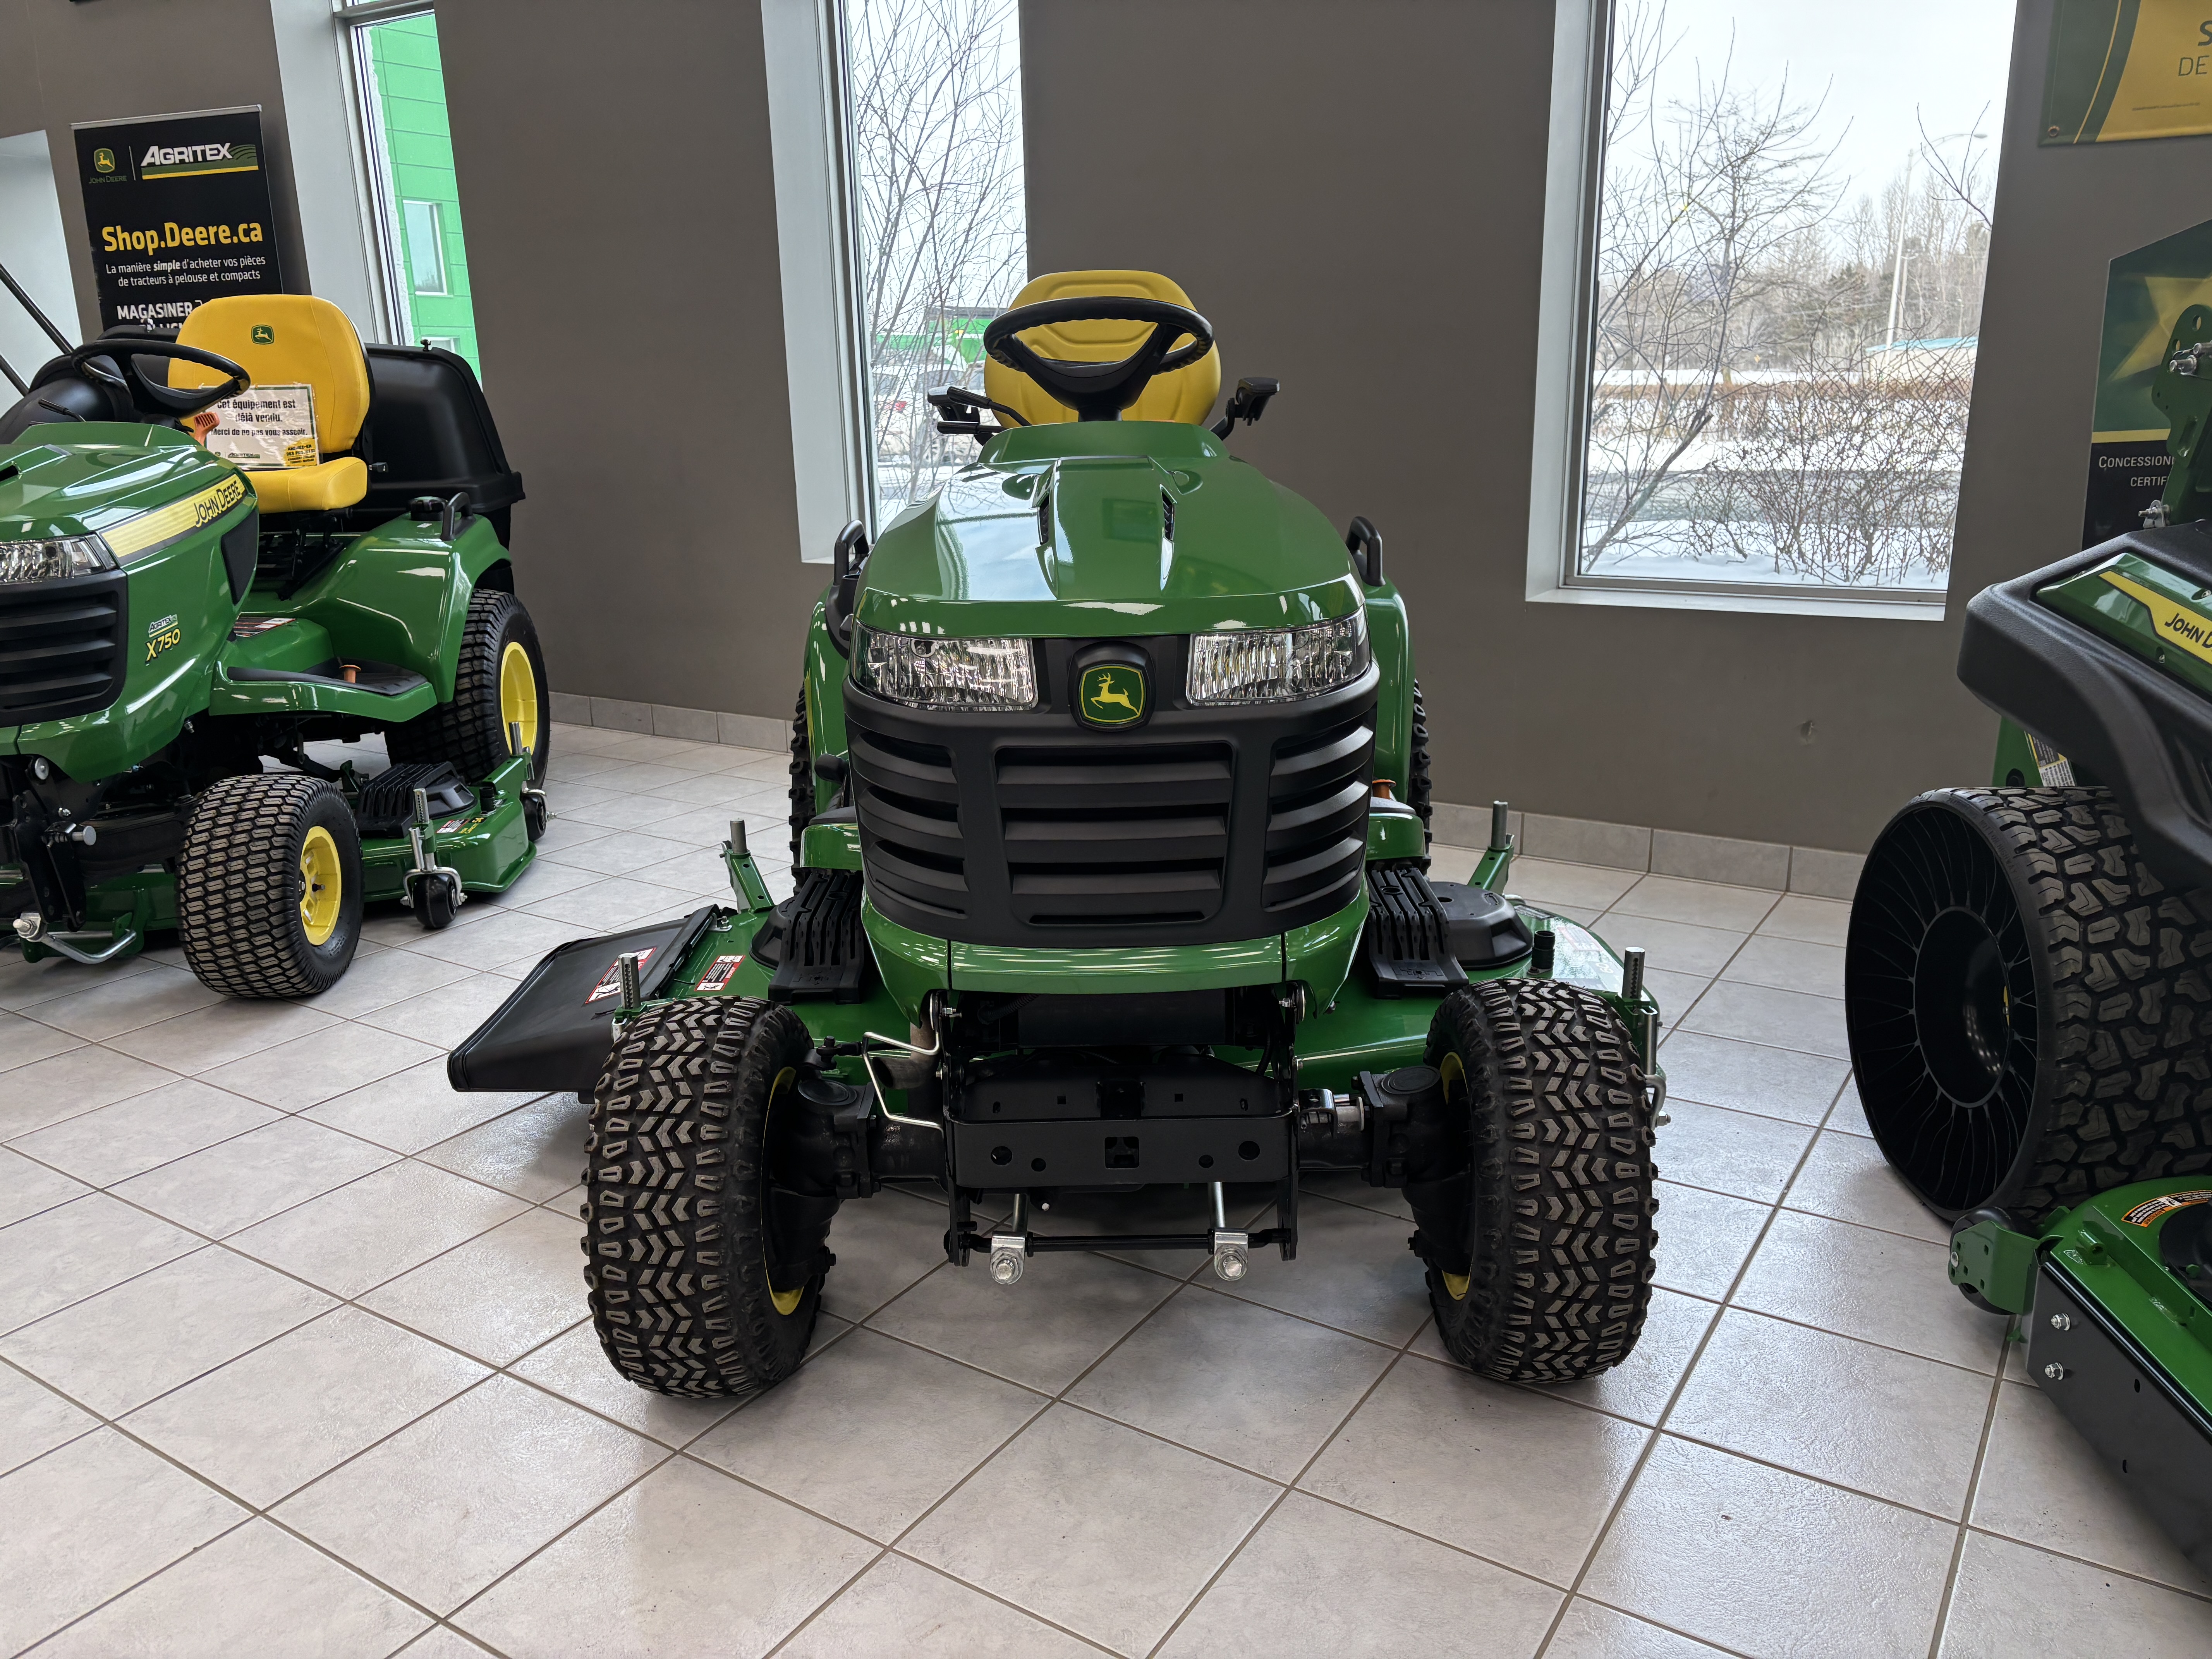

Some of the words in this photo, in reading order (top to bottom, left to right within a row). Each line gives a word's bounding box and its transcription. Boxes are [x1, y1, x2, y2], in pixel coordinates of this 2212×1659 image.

[140, 143, 232, 166] AGRITEX
[102, 222, 263, 256] Shop.Deere.ca
[106, 264, 116, 274] La
[118, 262, 151, 273] manière
[153, 259, 180, 272] simple
[182, 258, 221, 269] d'acheter
[223, 258, 238, 267] vos
[240, 255, 266, 268] pièces
[118, 277, 129, 287] de
[130, 275, 167, 286] tracteurs
[168, 274, 173, 284] à
[175, 273, 208, 285] pelouse
[210, 272, 219, 281] et
[221, 270, 260, 282] compacts
[117, 302, 192, 319] MAGASINER
[217, 400, 230, 409] Cet
[232, 399, 281, 410] équipement
[283, 399, 295, 408] est
[255, 413, 283, 422] vendu.
[194, 496, 220, 525] JOHN
[216, 480, 241, 510] DEERE
[149, 617, 172, 632] AGRITEX
[2164, 613, 2205, 643] JOHN
[146, 628, 180, 661] X750
